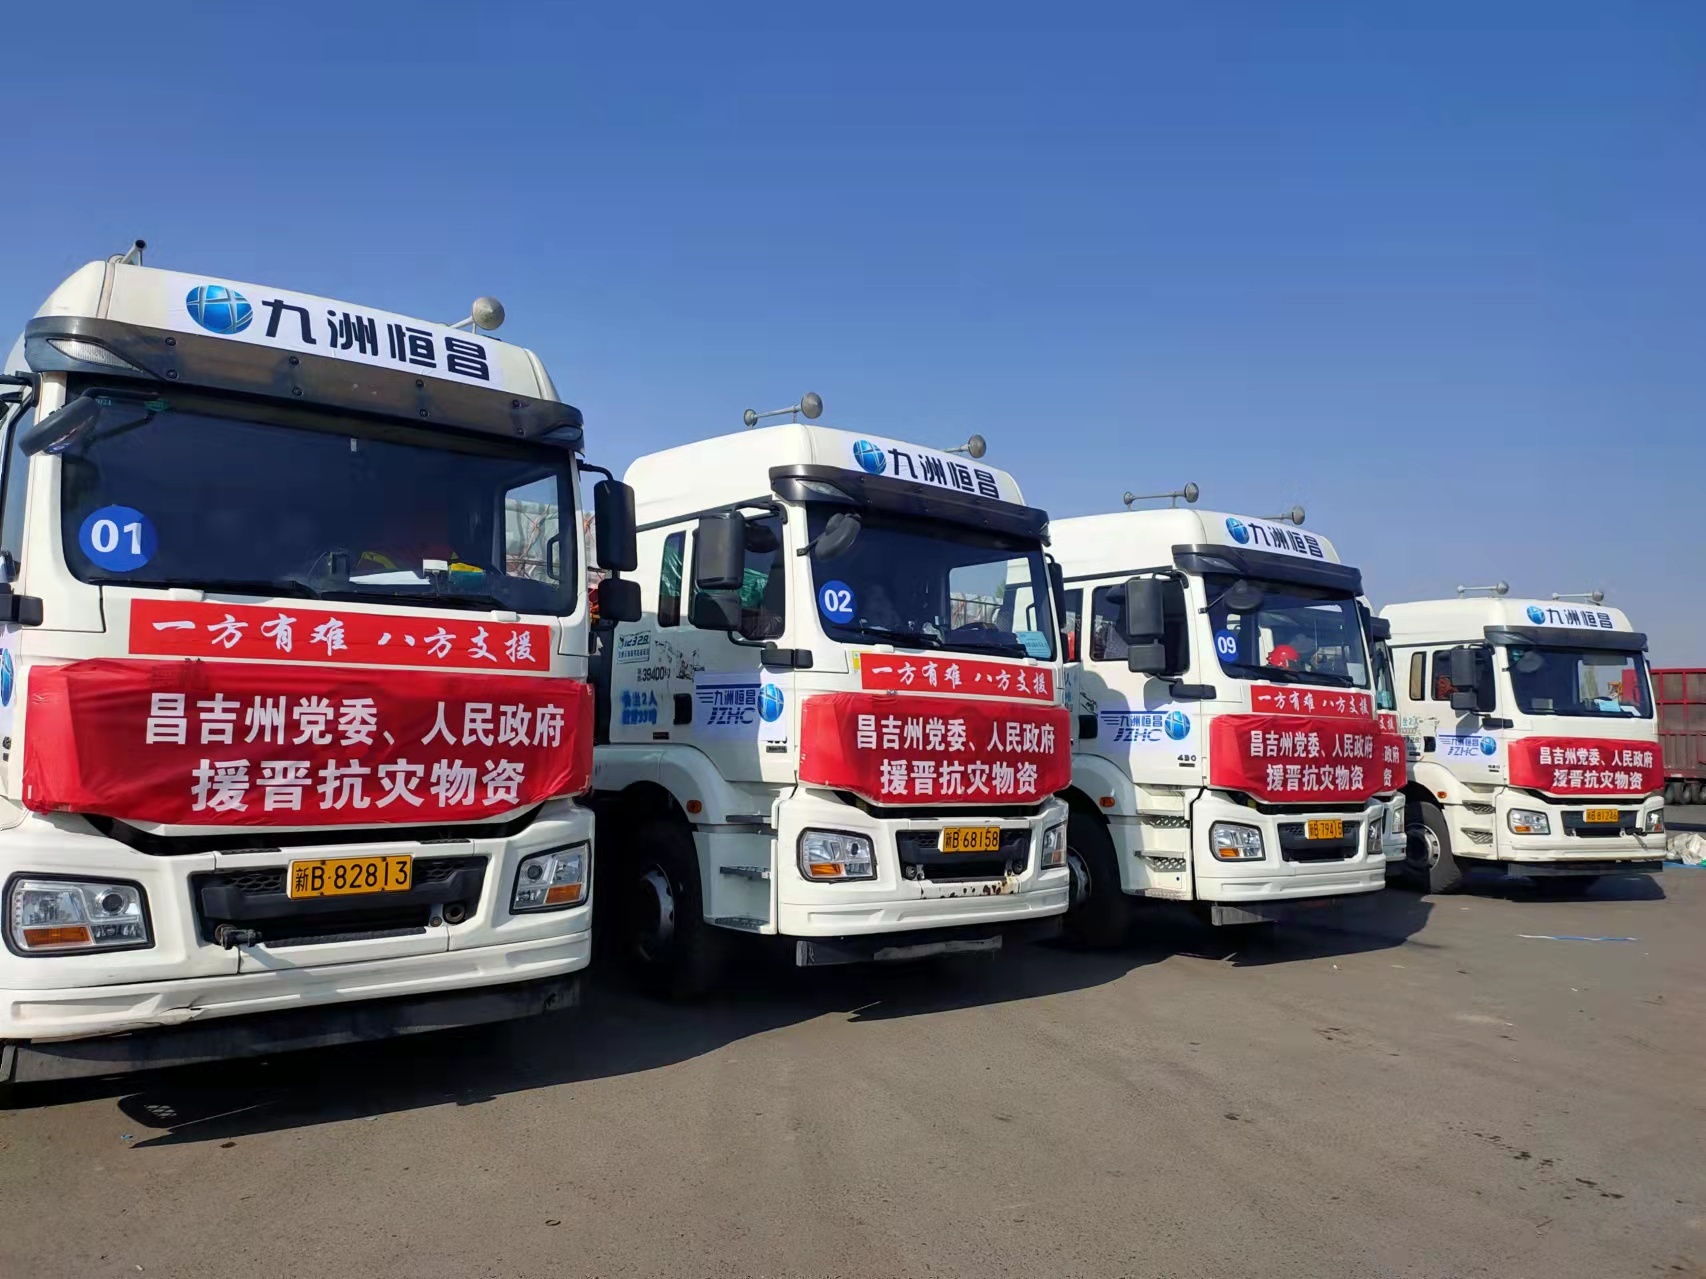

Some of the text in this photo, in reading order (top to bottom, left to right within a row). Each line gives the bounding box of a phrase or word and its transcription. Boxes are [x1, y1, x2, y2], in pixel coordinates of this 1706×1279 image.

[261, 299, 490, 382] 九洲恒昌
[888, 448, 999, 499] 九洲恒昌
[91, 518, 144, 556] 01
[1248, 523, 1323, 558] 九洲恒昌
[824, 589, 853, 613] 02
[1546, 608, 1613, 629] 九洲恒昌
[152, 612, 537, 664] 一方有难 八方支援
[1217, 636, 1237, 654] 09
[872, 660, 963, 689] 一方有难
[974, 671, 1048, 695] 八方支援
[714, 689, 756, 706] 九洲恒昌
[145, 692, 566, 749] 昌吉州党委、人民政府
[707, 707, 756, 725] JZHC
[1120, 715, 1163, 727] 九洲恒昌
[857, 714, 1055, 754] 昌吉州党委、人民政府
[1113, 728, 1163, 742] JZHC
[1250, 730, 1373, 759] 昌吉州党委、人民政府
[1540, 746, 1653, 769] 昌吉州党委、人民政府
[191, 758, 526, 813] 援晋抗灾物资
[880, 759, 1038, 795] 援晋抗灾物资
[1266, 763, 1364, 791] 援晋抗灾物资
